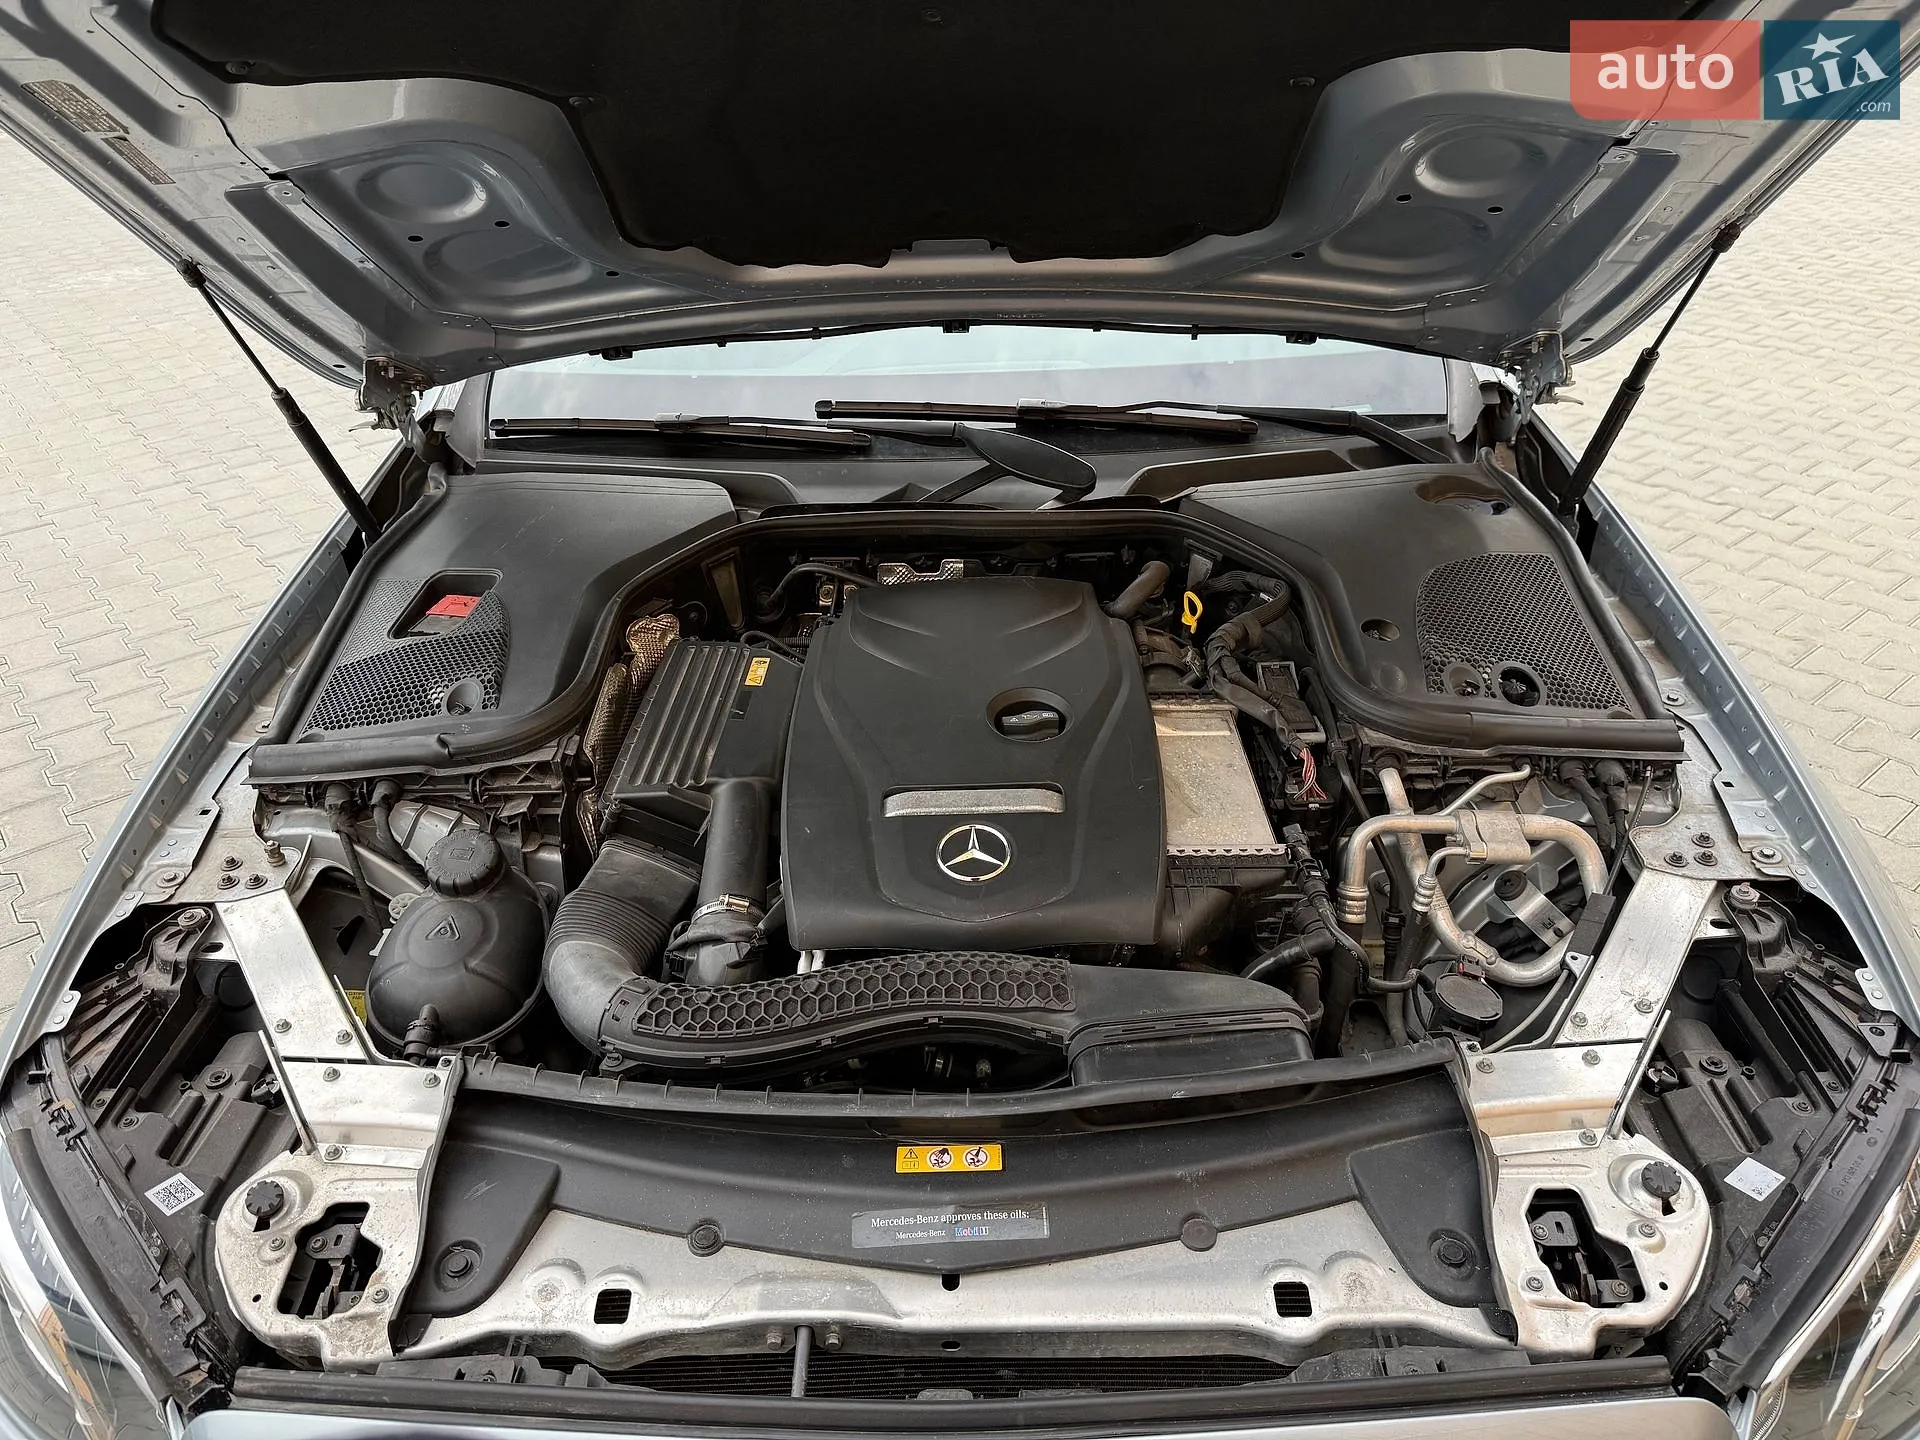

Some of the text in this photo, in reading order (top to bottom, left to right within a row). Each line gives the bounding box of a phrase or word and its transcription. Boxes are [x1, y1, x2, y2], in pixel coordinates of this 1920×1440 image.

[871, 1209, 1030, 1227] Mercedes-Benz approves these oils:
[895, 1229, 946, 1240] Mercedes-Benz
